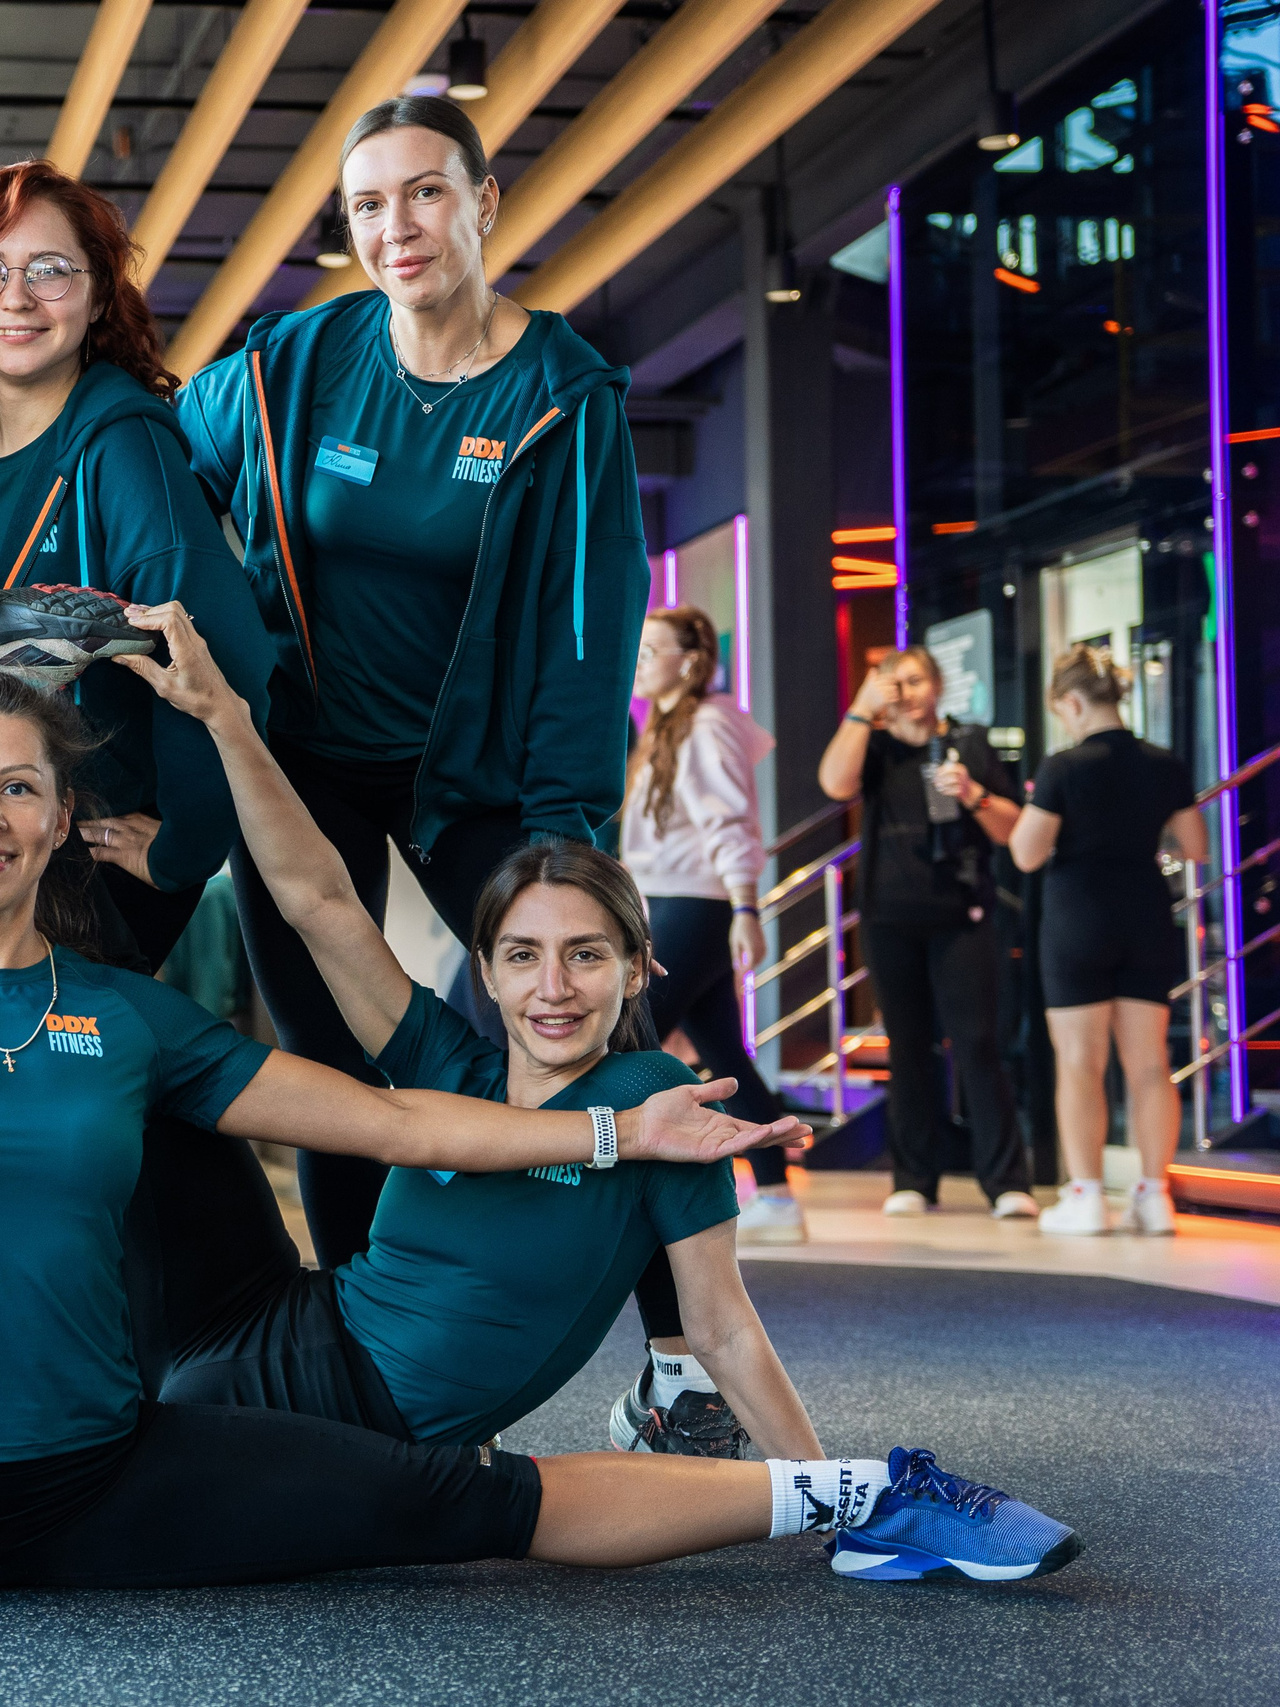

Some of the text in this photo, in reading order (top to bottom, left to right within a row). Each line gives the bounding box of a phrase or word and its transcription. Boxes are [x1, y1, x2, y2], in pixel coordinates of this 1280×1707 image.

[458, 435, 507, 460] DDX
[451, 456, 503, 484] FITNESS
[46, 1013, 100, 1036] DDX
[48, 1031, 104, 1058] FITNESS
